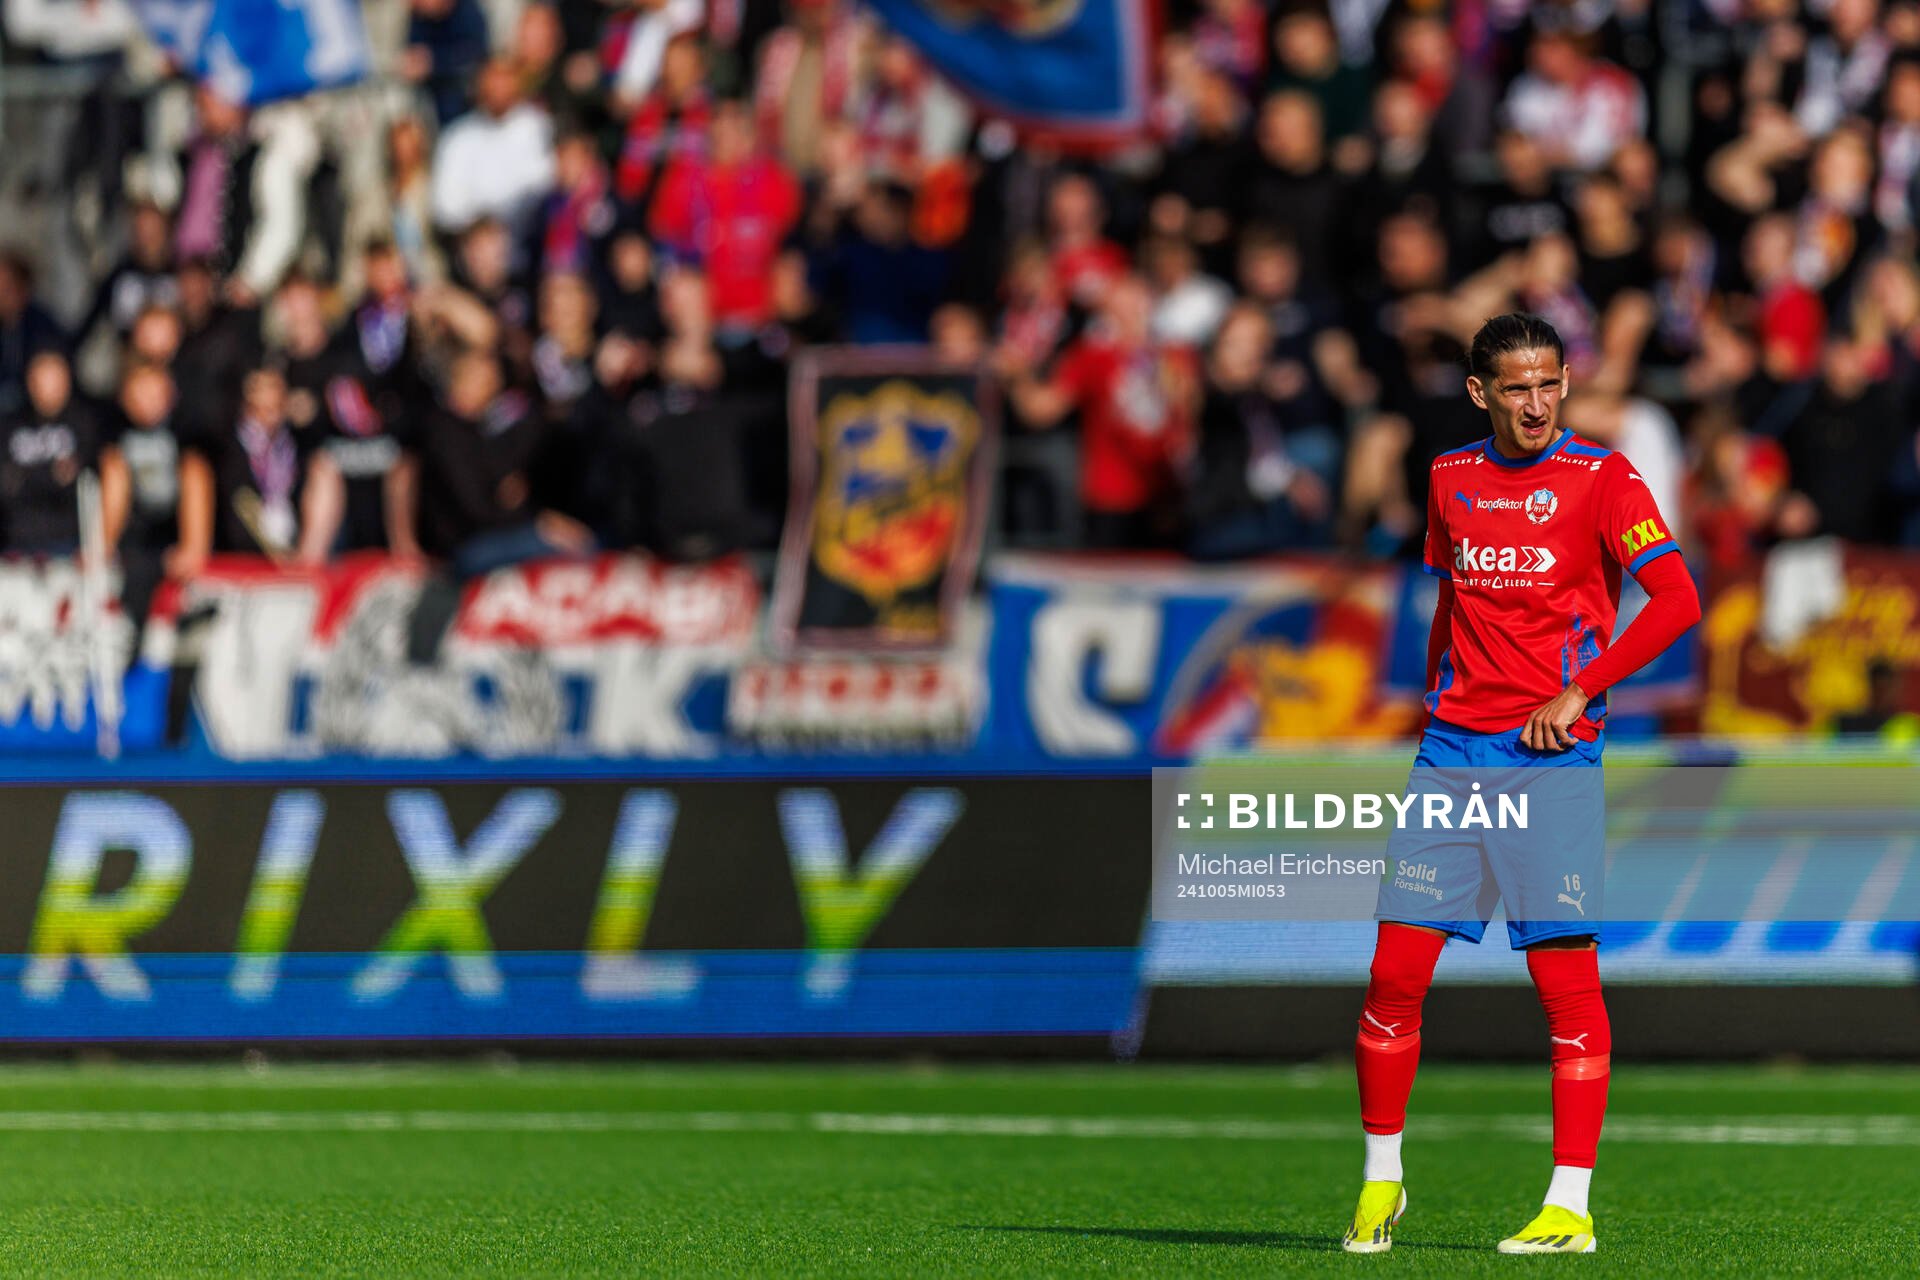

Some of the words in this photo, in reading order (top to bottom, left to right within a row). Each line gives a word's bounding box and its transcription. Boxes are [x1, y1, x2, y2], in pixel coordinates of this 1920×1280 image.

[1550, 454, 1589, 467] SVALNER
[1621, 518, 1666, 557] XXL
[1453, 537, 1517, 572] akea
[1481, 578, 1491, 587] OF
[1504, 579, 1533, 588] ELEDA
[1397, 859, 1438, 883] Solid
[1563, 873, 1580, 892] 16
[20, 788, 966, 1001] RIXLY
[1394, 876, 1443, 900] Försäkring
